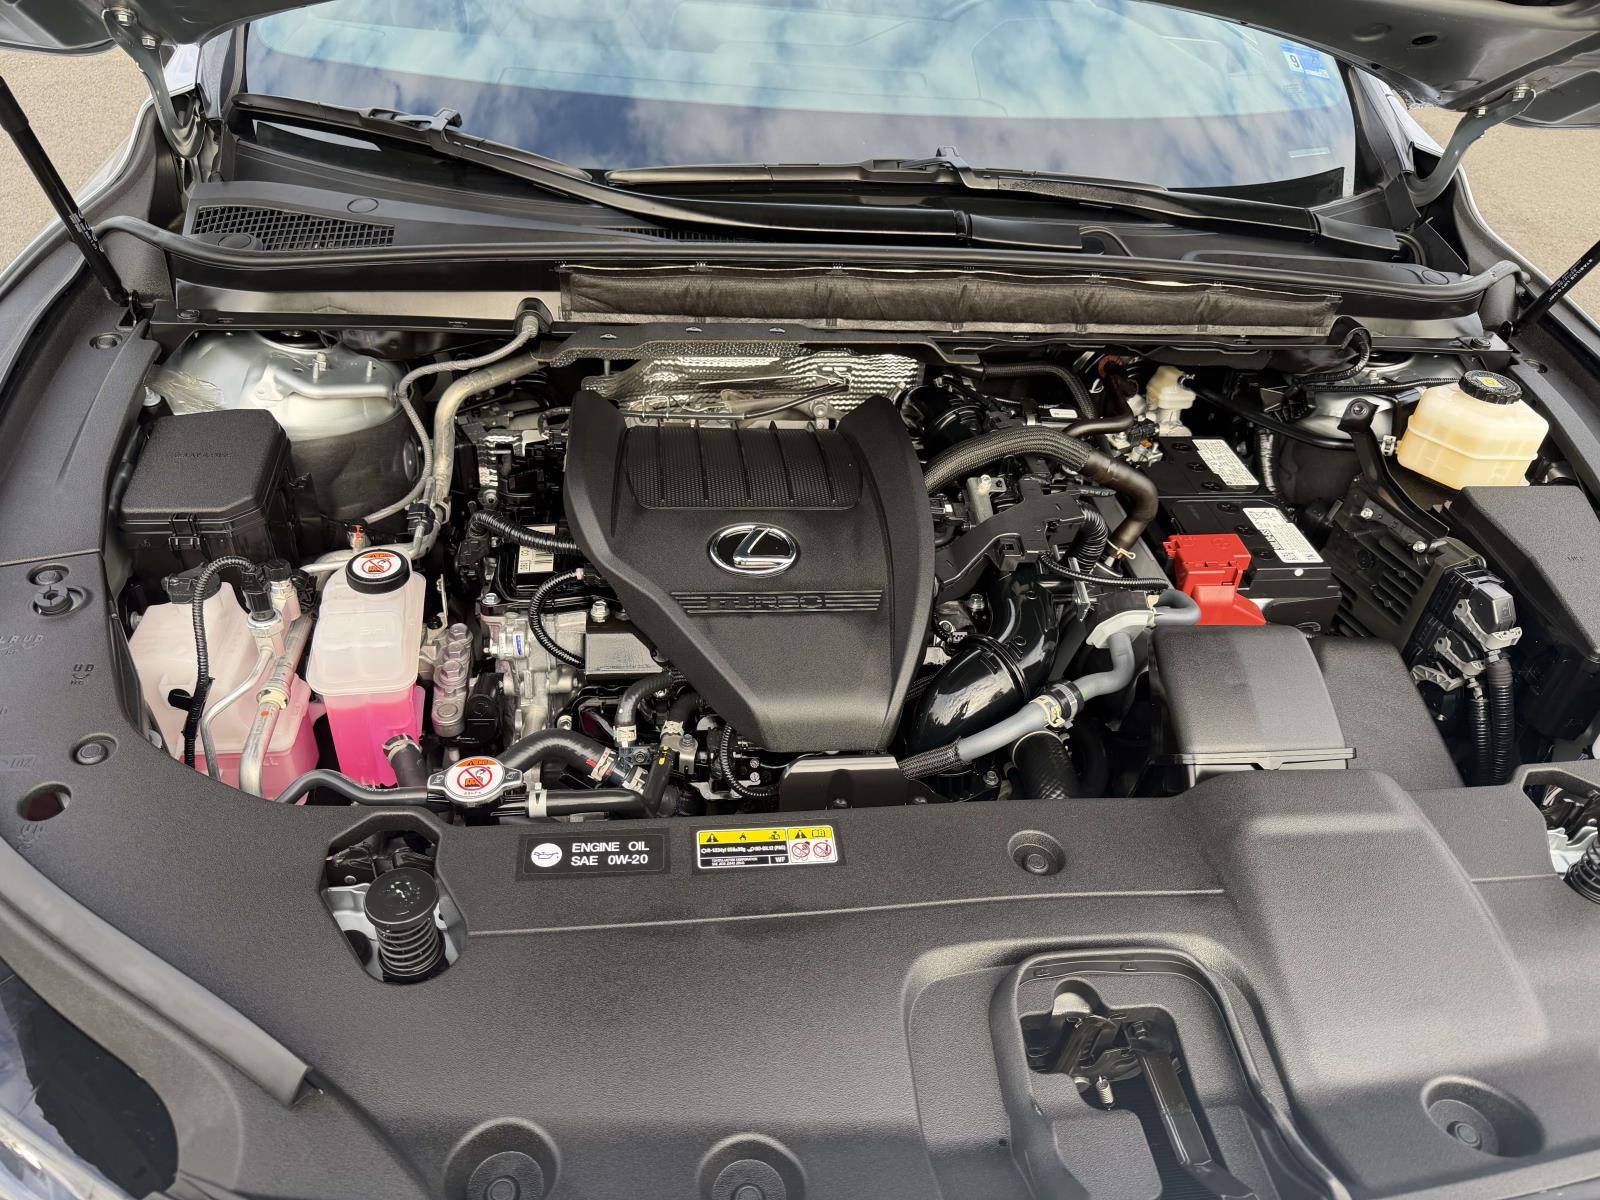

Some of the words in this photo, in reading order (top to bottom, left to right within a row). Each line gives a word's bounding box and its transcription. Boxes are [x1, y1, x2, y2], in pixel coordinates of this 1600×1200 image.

[571, 841, 620, 853] ENGINE
[628, 840, 650, 852] OIL
[570, 855, 599, 866] SAE
[607, 854, 649, 865] 0W-20
